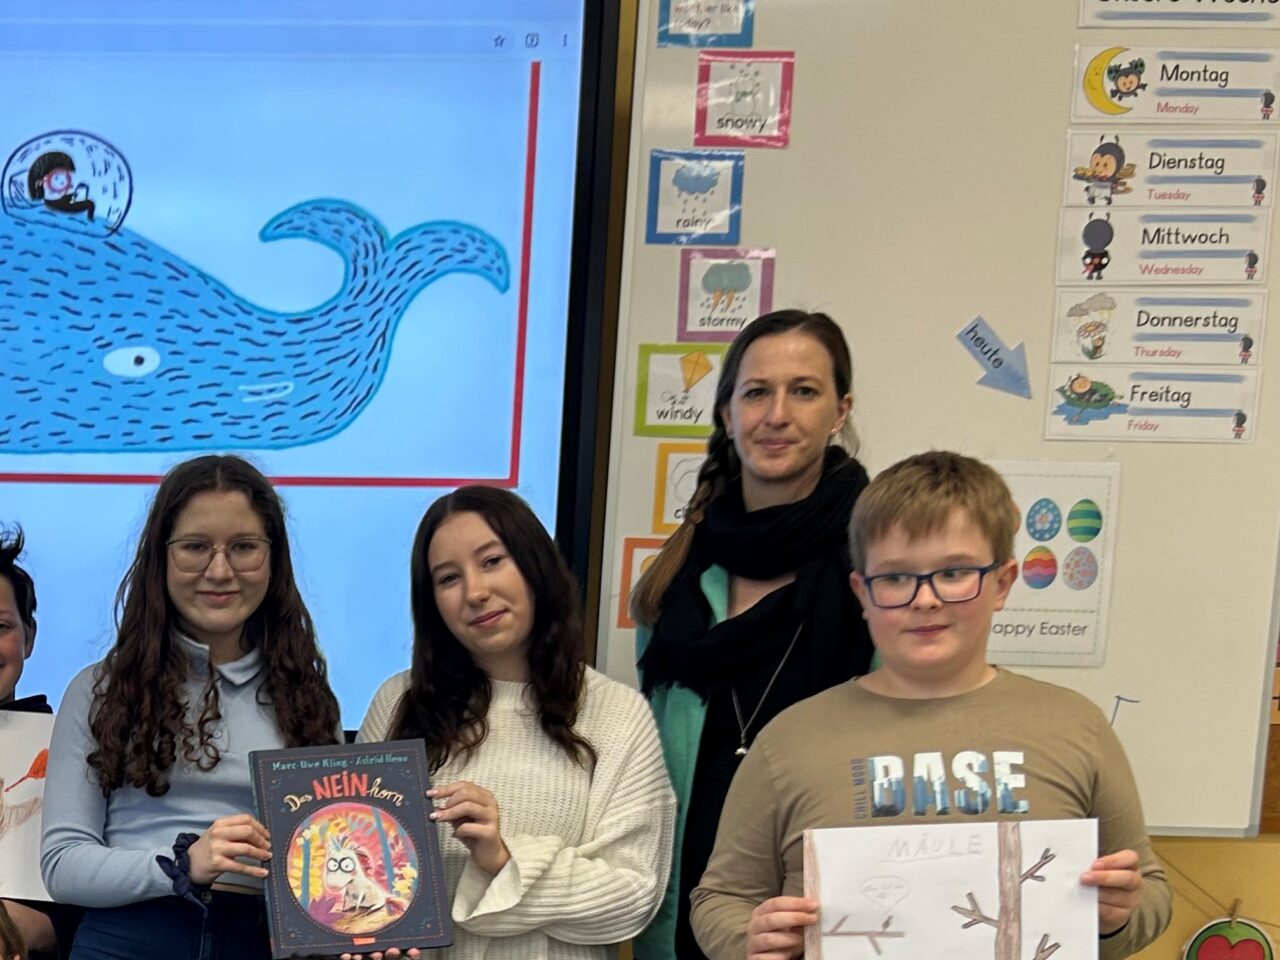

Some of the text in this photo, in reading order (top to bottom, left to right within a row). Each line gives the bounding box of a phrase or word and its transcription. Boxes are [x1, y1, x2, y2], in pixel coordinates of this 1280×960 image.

[1160, 64, 1230, 88] Montag
[1156, 102, 1200, 116] Monday
[716, 117, 769, 133] snowy
[1148, 152, 1226, 175] Dienstag
[1147, 188, 1192, 201] Tuesday
[676, 216, 712, 232] rainy
[1140, 227, 1230, 245] Mittwoch
[1138, 263, 1204, 276] Wednesday
[698, 314, 748, 330] stormy
[1136, 309, 1239, 334] Donnerstag
[965, 323, 1003, 369] heute
[1133, 346, 1183, 359] Thursday
[1129, 384, 1192, 409] Freitag
[656, 406, 704, 424] windy
[1126, 419, 1160, 432] Friday
[992, 620, 1088, 638] appy Easter
[867, 750, 1030, 818] BASE
[283, 793, 313, 813] Das
